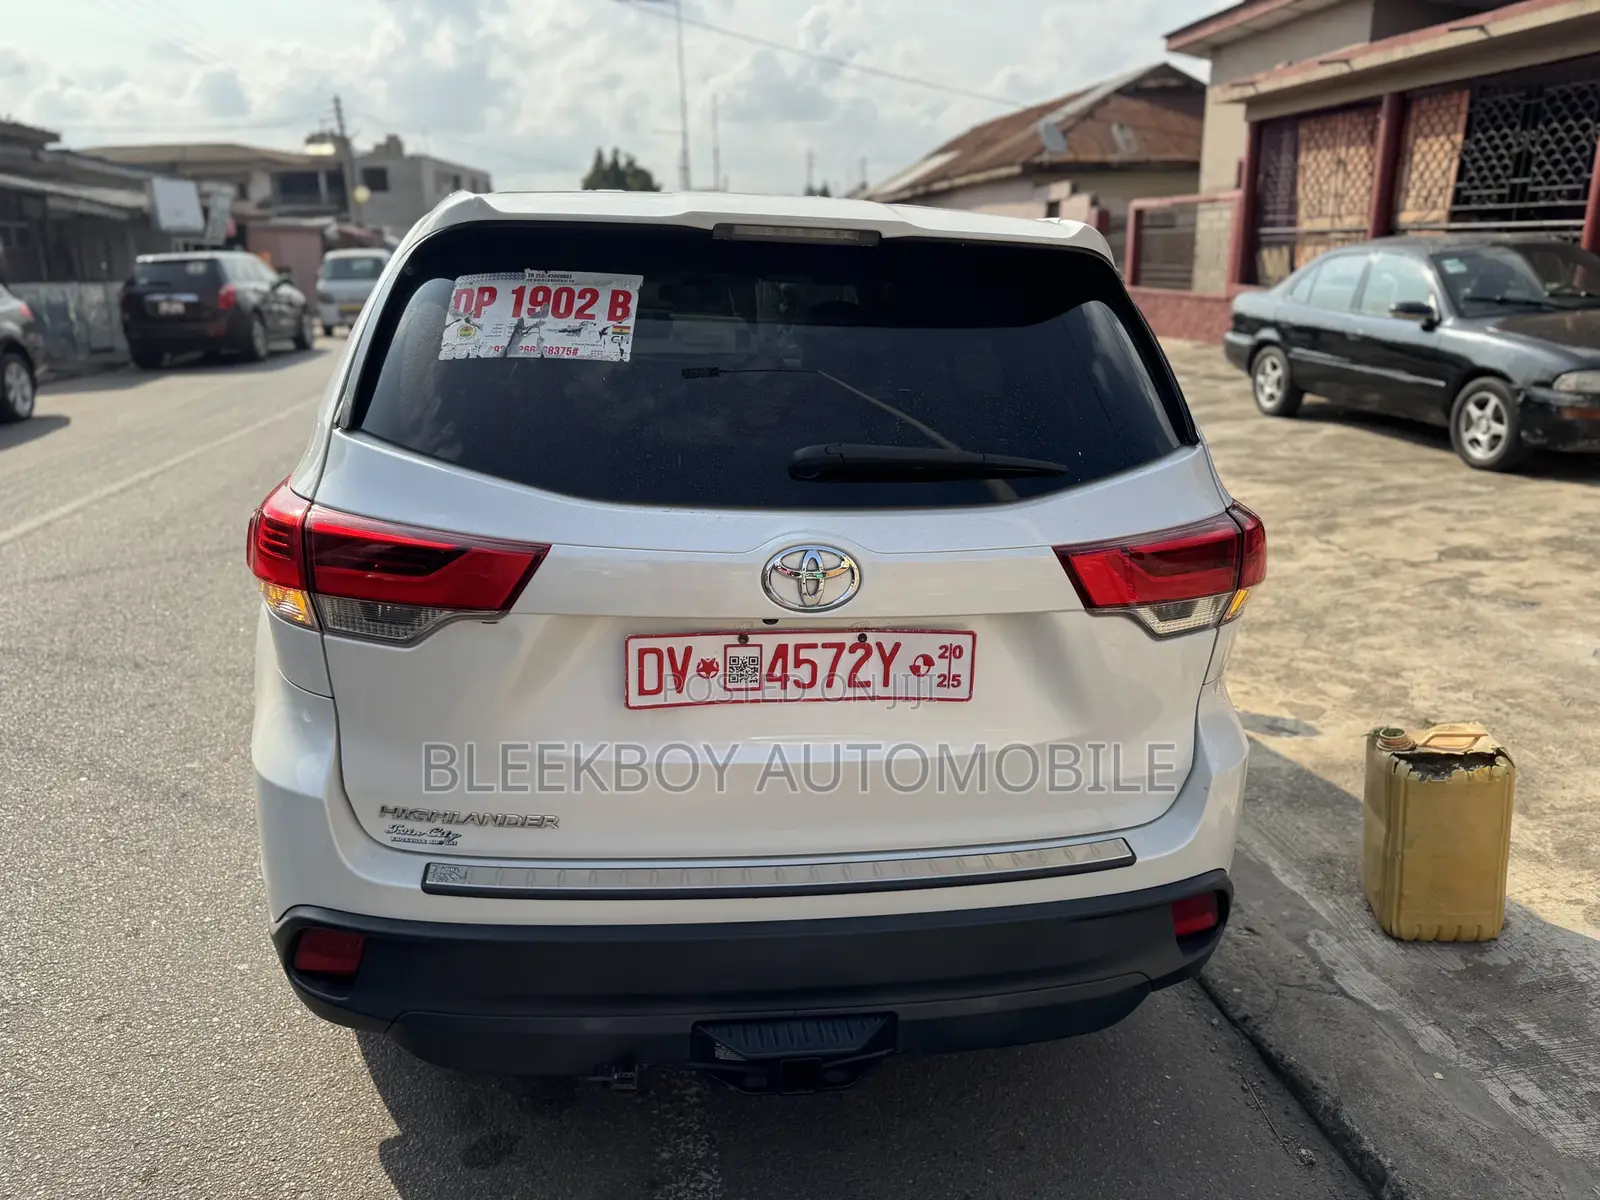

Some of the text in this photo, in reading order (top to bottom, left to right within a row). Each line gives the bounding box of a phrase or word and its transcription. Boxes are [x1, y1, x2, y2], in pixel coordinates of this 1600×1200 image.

[454, 286, 632, 322] DP 1902 B
[937, 644, 964, 660] 20
[638, 641, 902, 696] DV 4572Y
[936, 673, 962, 688] 25
[379, 805, 560, 829] HIGHLANDER
